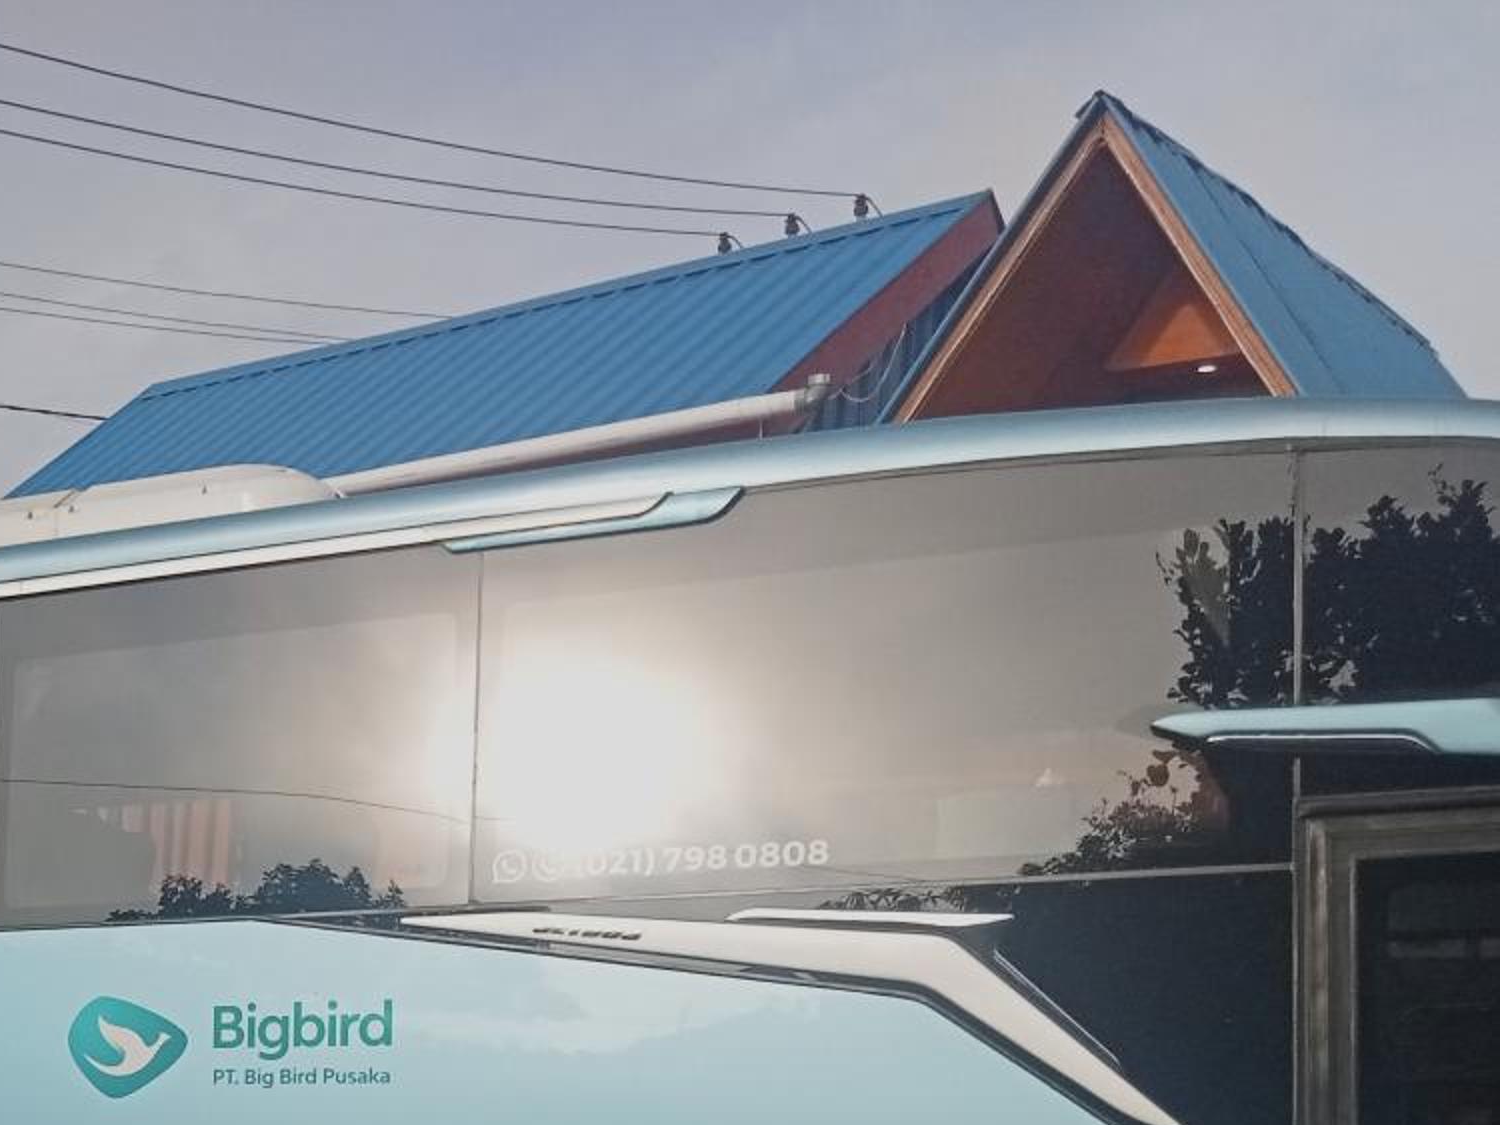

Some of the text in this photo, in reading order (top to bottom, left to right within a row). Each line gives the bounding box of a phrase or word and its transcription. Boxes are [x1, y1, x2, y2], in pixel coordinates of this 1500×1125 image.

[667, 842, 727, 872] 798
[735, 839, 829, 868] 0808
[213, 1000, 392, 1061] Bigbird
[213, 1068, 391, 1088] PT. Big Bird Pusaka
